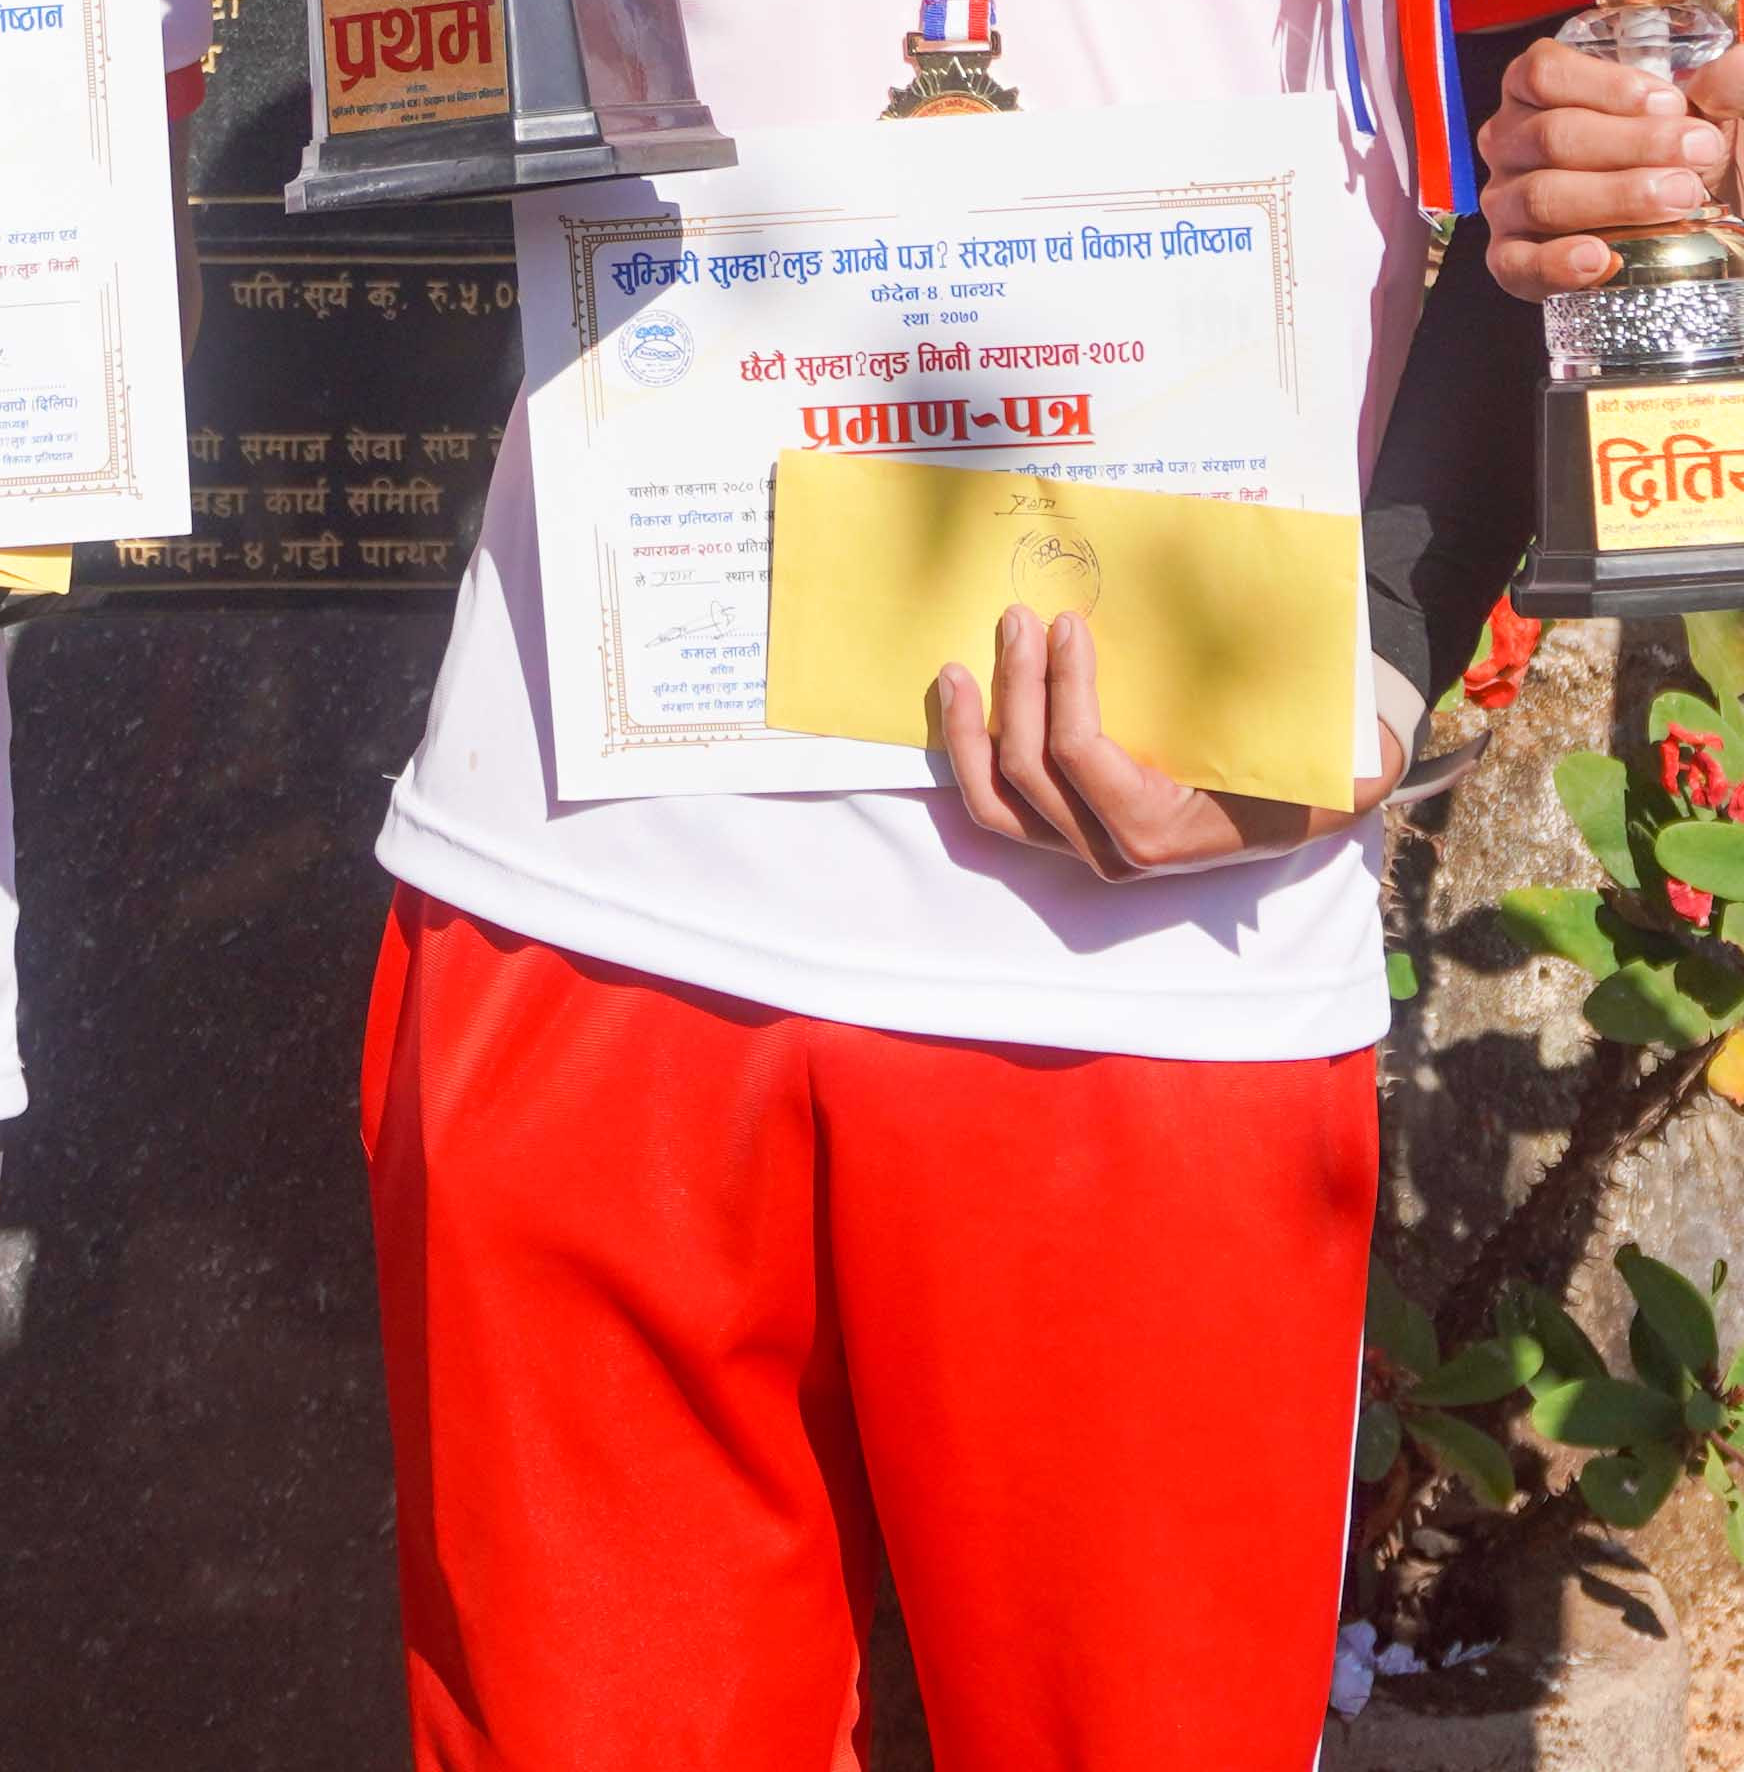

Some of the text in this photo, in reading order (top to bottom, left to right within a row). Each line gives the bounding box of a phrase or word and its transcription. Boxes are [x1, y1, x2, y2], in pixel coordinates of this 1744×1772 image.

[832, 238, 889, 275] आम्बे
[958, 236, 1036, 269] संरक्षण
[1044, 231, 1073, 263] एवं
[1081, 225, 1152, 261] विकास
[1159, 219, 1253, 261] प्रतिष्ठान
[917, 341, 971, 374] मिनी
[799, 394, 1095, 451] प्रमाण-पत्र
[344, 477, 445, 516] समिति
